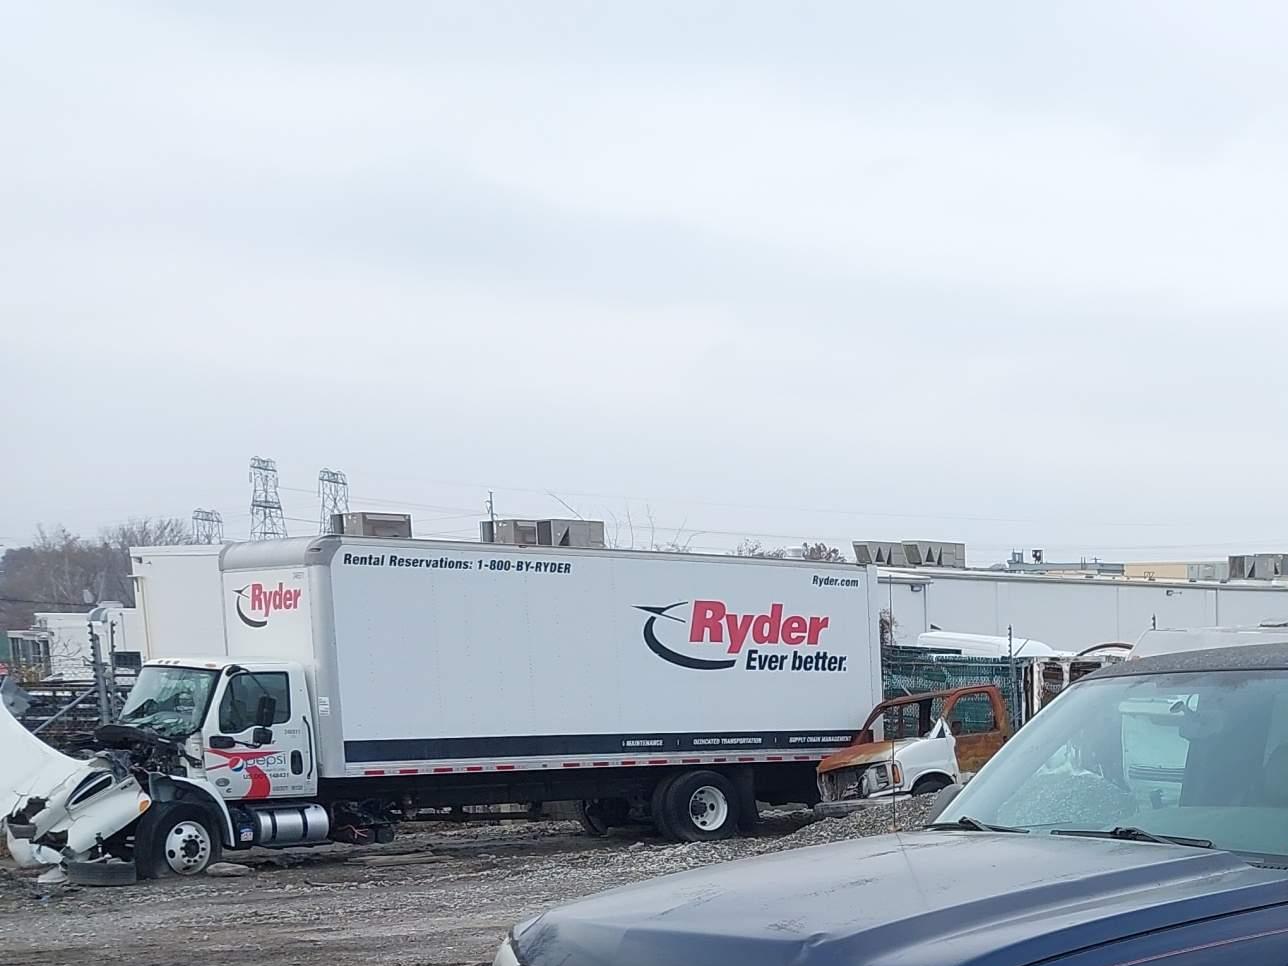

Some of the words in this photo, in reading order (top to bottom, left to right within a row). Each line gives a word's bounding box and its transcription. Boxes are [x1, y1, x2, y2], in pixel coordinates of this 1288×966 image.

[343, 553, 385, 566] Rental
[389, 555, 473, 570] Reservations:
[477, 559, 572, 574] 1-800-BY-RYDER
[812, 575, 859, 587] Ryder.com
[251, 582, 301, 617] Ryder
[689, 600, 829, 654] Ryder
[745, 649, 788, 671] Ever
[791, 651, 847, 671] better.
[246, 753, 287, 768] pepsi
